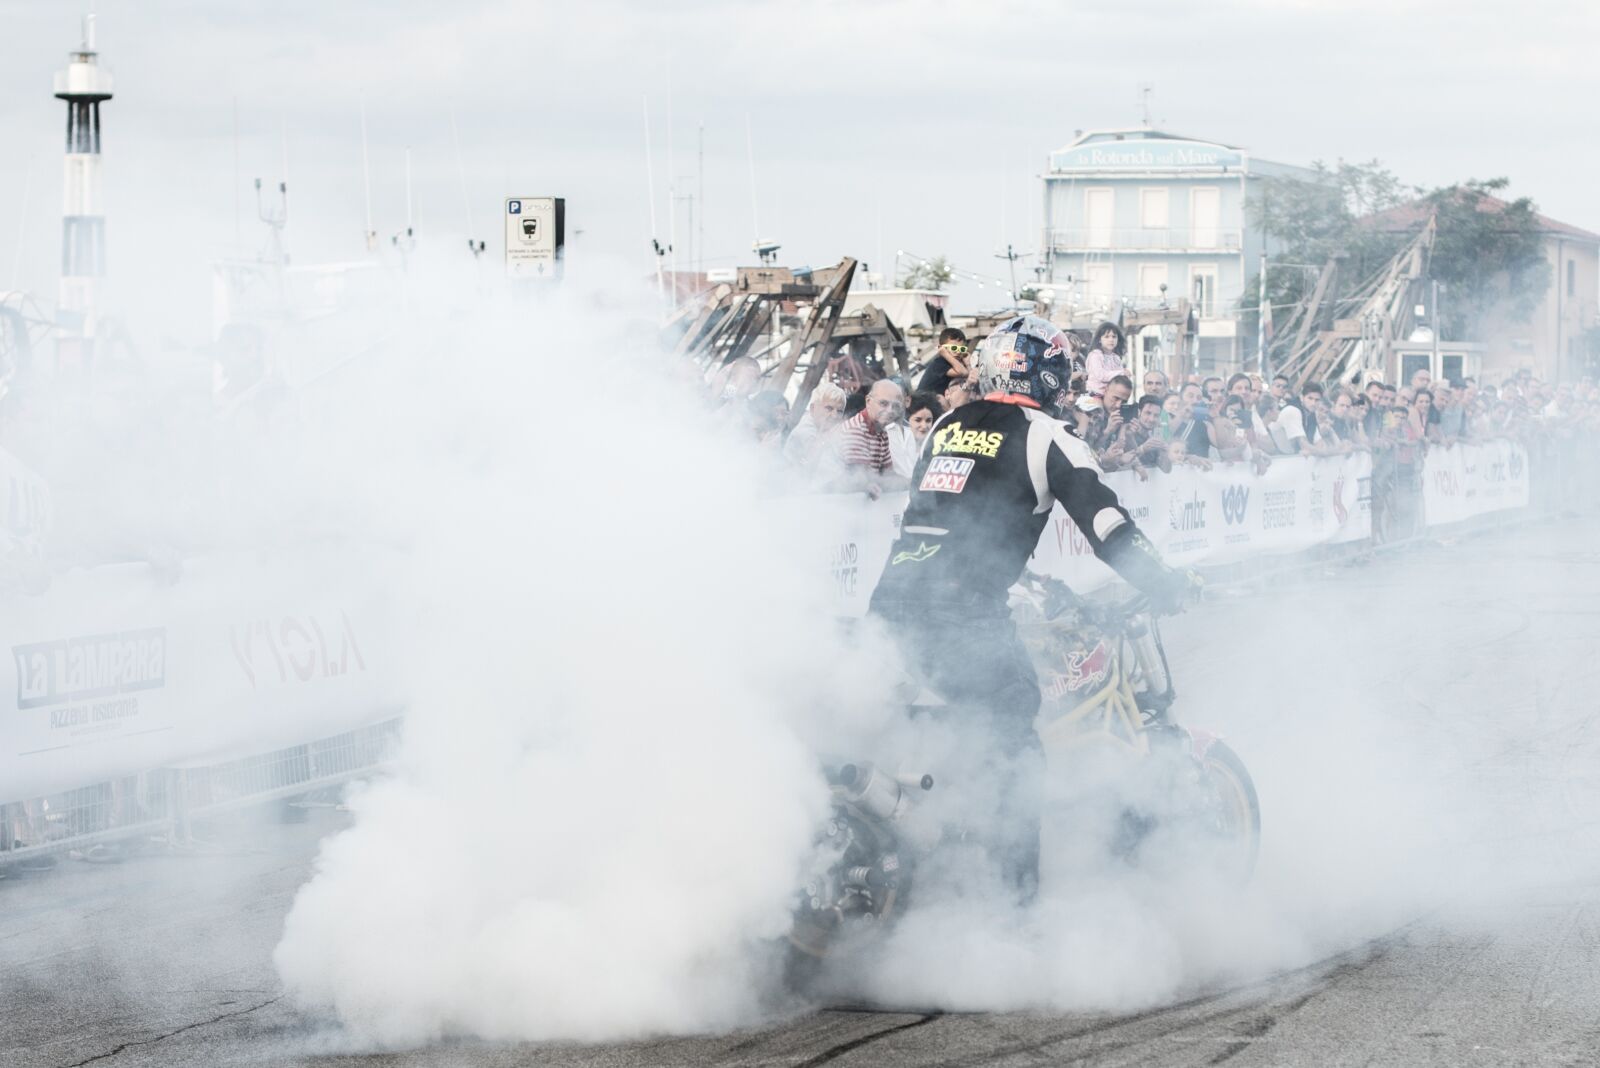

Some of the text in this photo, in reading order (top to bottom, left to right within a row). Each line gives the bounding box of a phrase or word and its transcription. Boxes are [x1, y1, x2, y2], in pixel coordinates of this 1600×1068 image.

[1091, 149, 1153, 165] Rotonda
[1156, 152, 1174, 164] sul
[1177, 149, 1217, 165] Mare
[951, 430, 1004, 449] ARAS
[929, 459, 971, 475] LIQUI
[922, 473, 965, 490] MOLY
